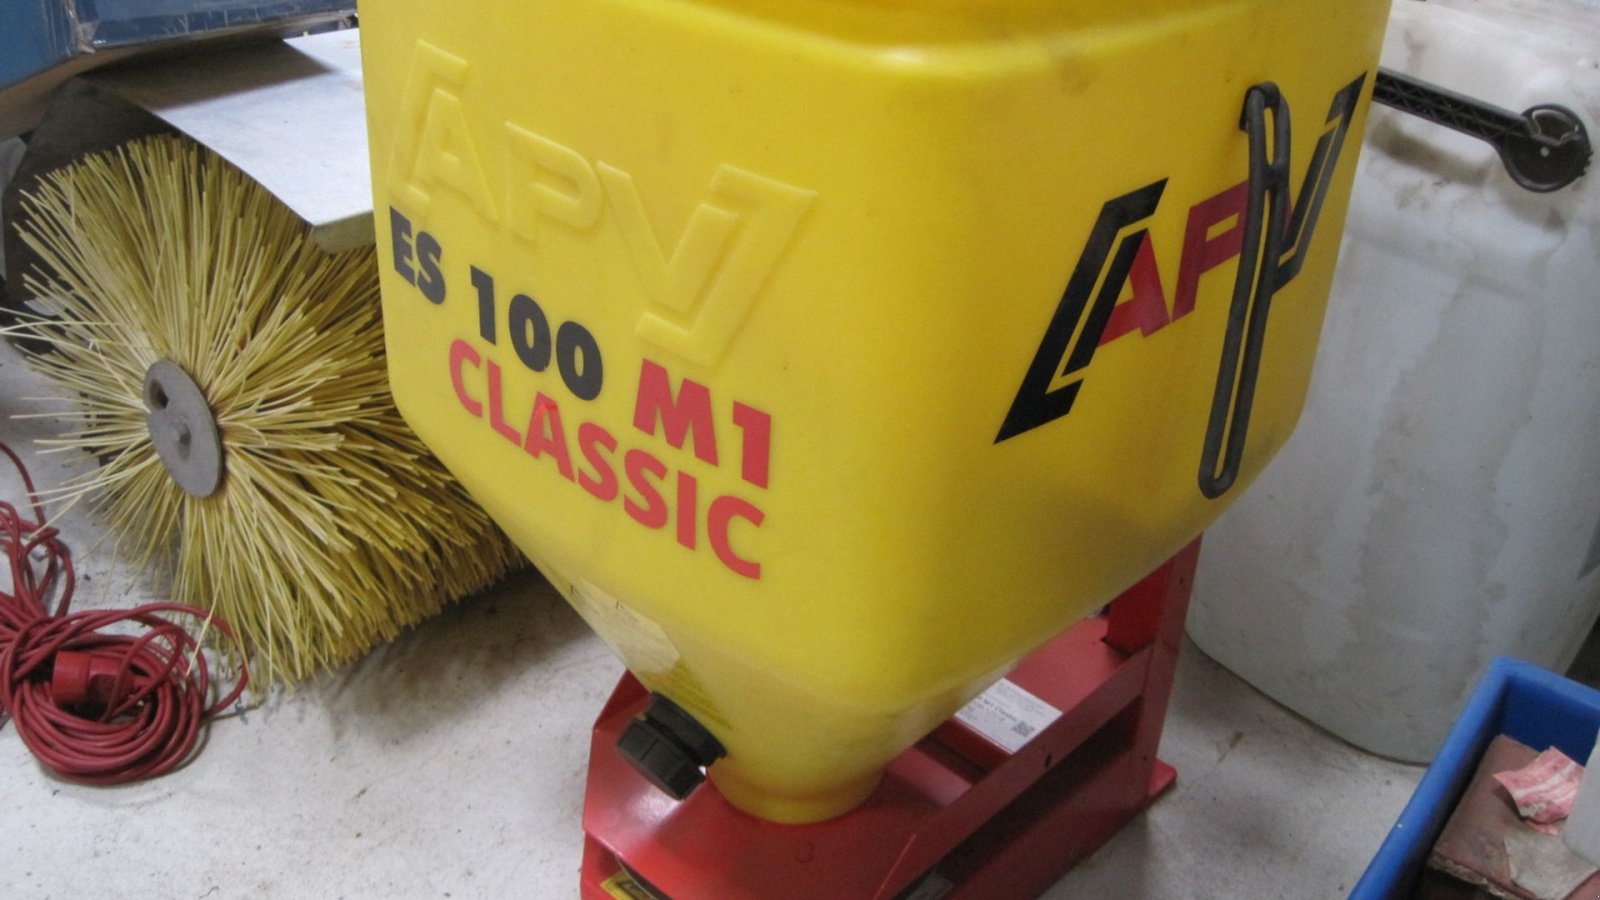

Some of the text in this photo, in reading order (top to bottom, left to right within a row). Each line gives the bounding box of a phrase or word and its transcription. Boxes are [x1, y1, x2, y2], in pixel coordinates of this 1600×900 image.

[389, 206, 772, 490] ES 100 M1
[449, 339, 766, 580] CLASSIC
